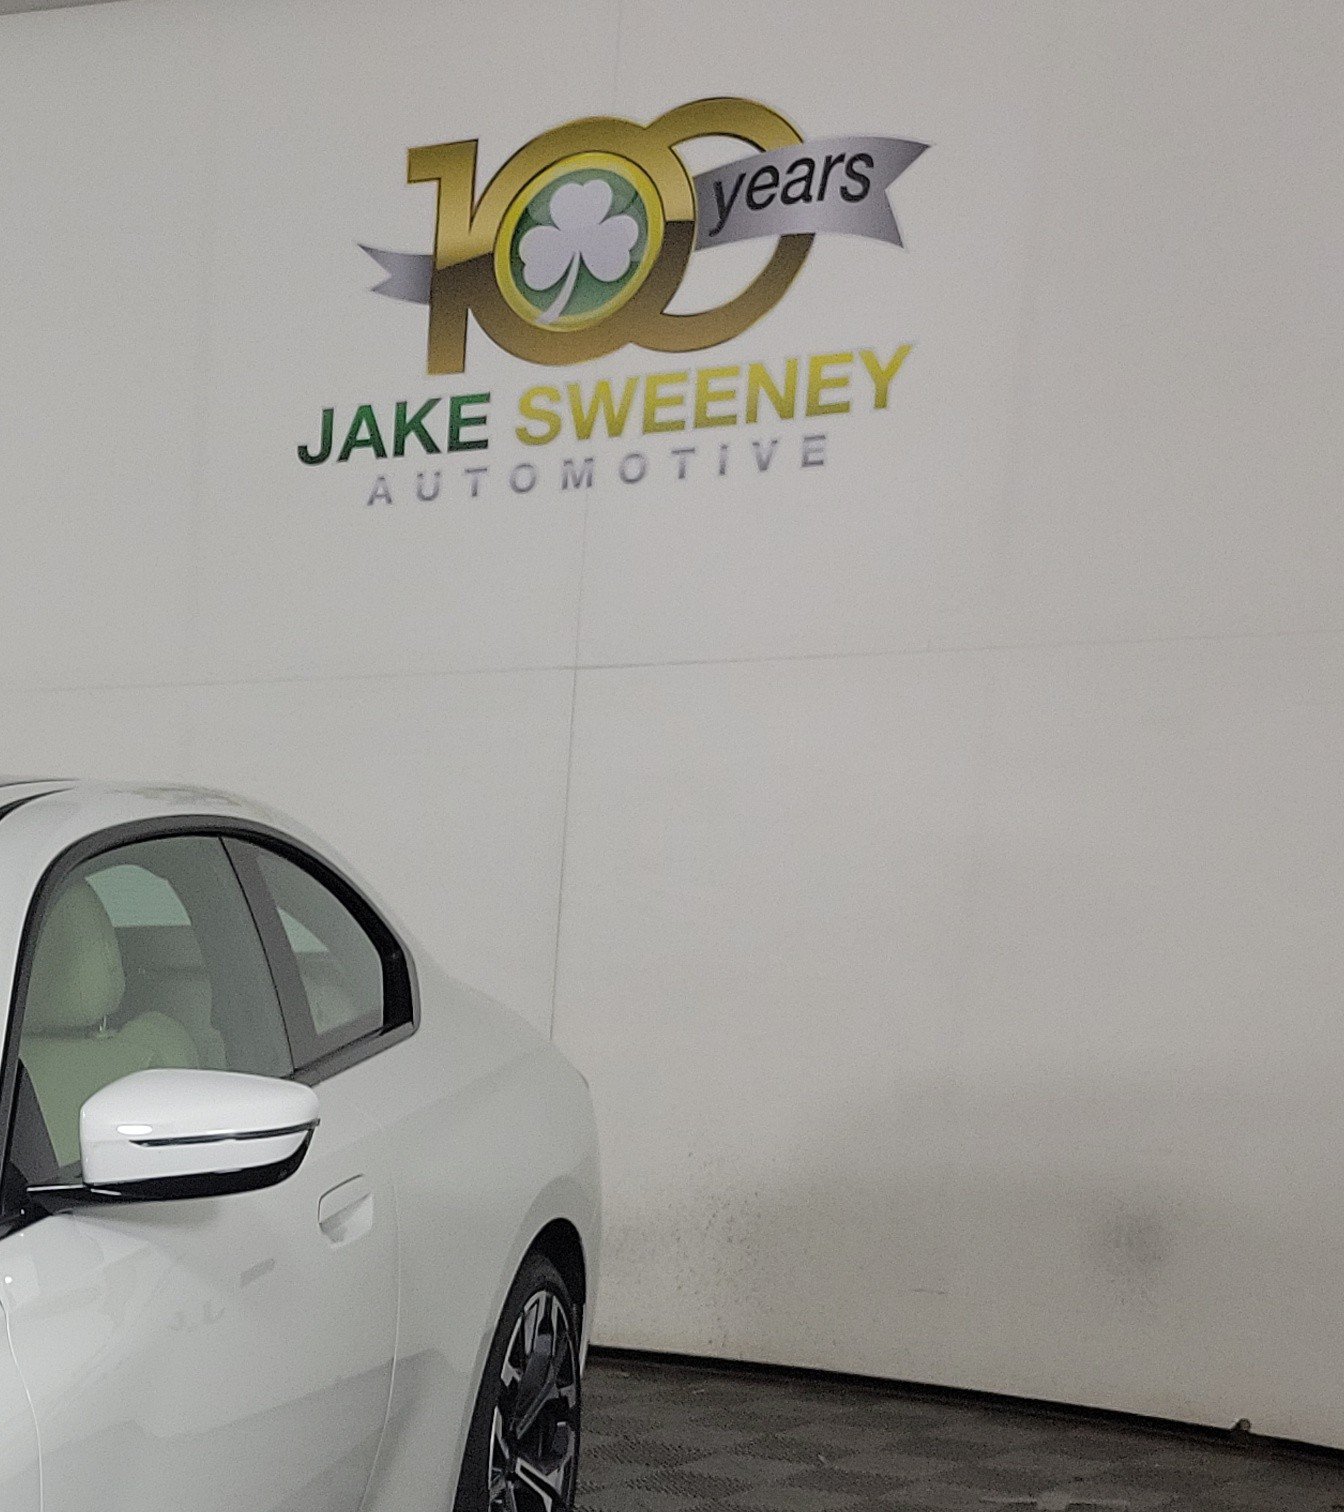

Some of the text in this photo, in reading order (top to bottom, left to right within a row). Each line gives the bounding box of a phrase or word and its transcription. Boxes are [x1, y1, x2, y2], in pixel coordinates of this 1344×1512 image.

[407, 96, 875, 375] 100 years
[297, 342, 914, 466] JAKE SWEENEY
[366, 433, 829, 507] AUTOMOTIVE
